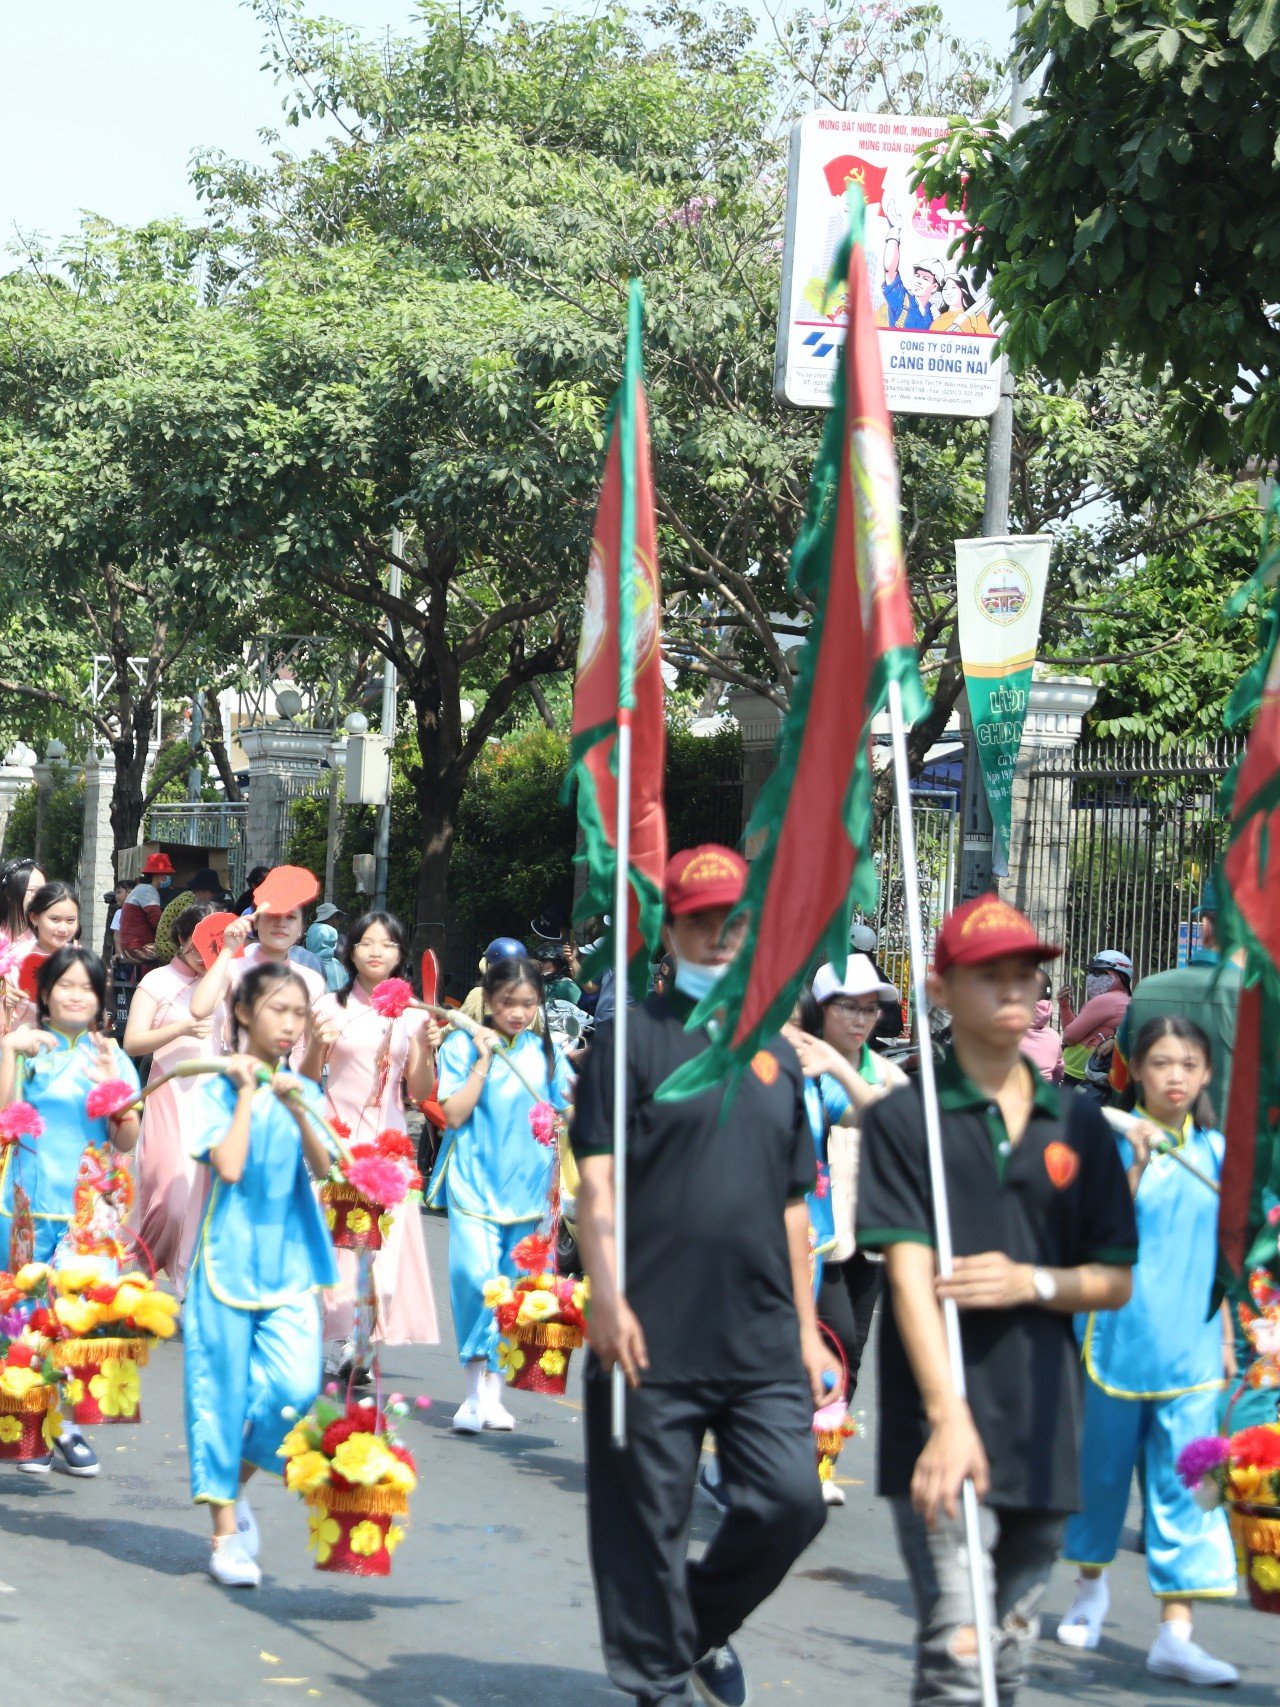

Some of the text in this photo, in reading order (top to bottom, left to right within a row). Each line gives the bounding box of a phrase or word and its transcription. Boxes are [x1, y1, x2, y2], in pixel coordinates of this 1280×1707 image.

[900, 339, 924, 352] CÔNG
[928, 342, 938, 353] TY
[890, 351, 988, 375] CẢNG ĐỒNG NAI
